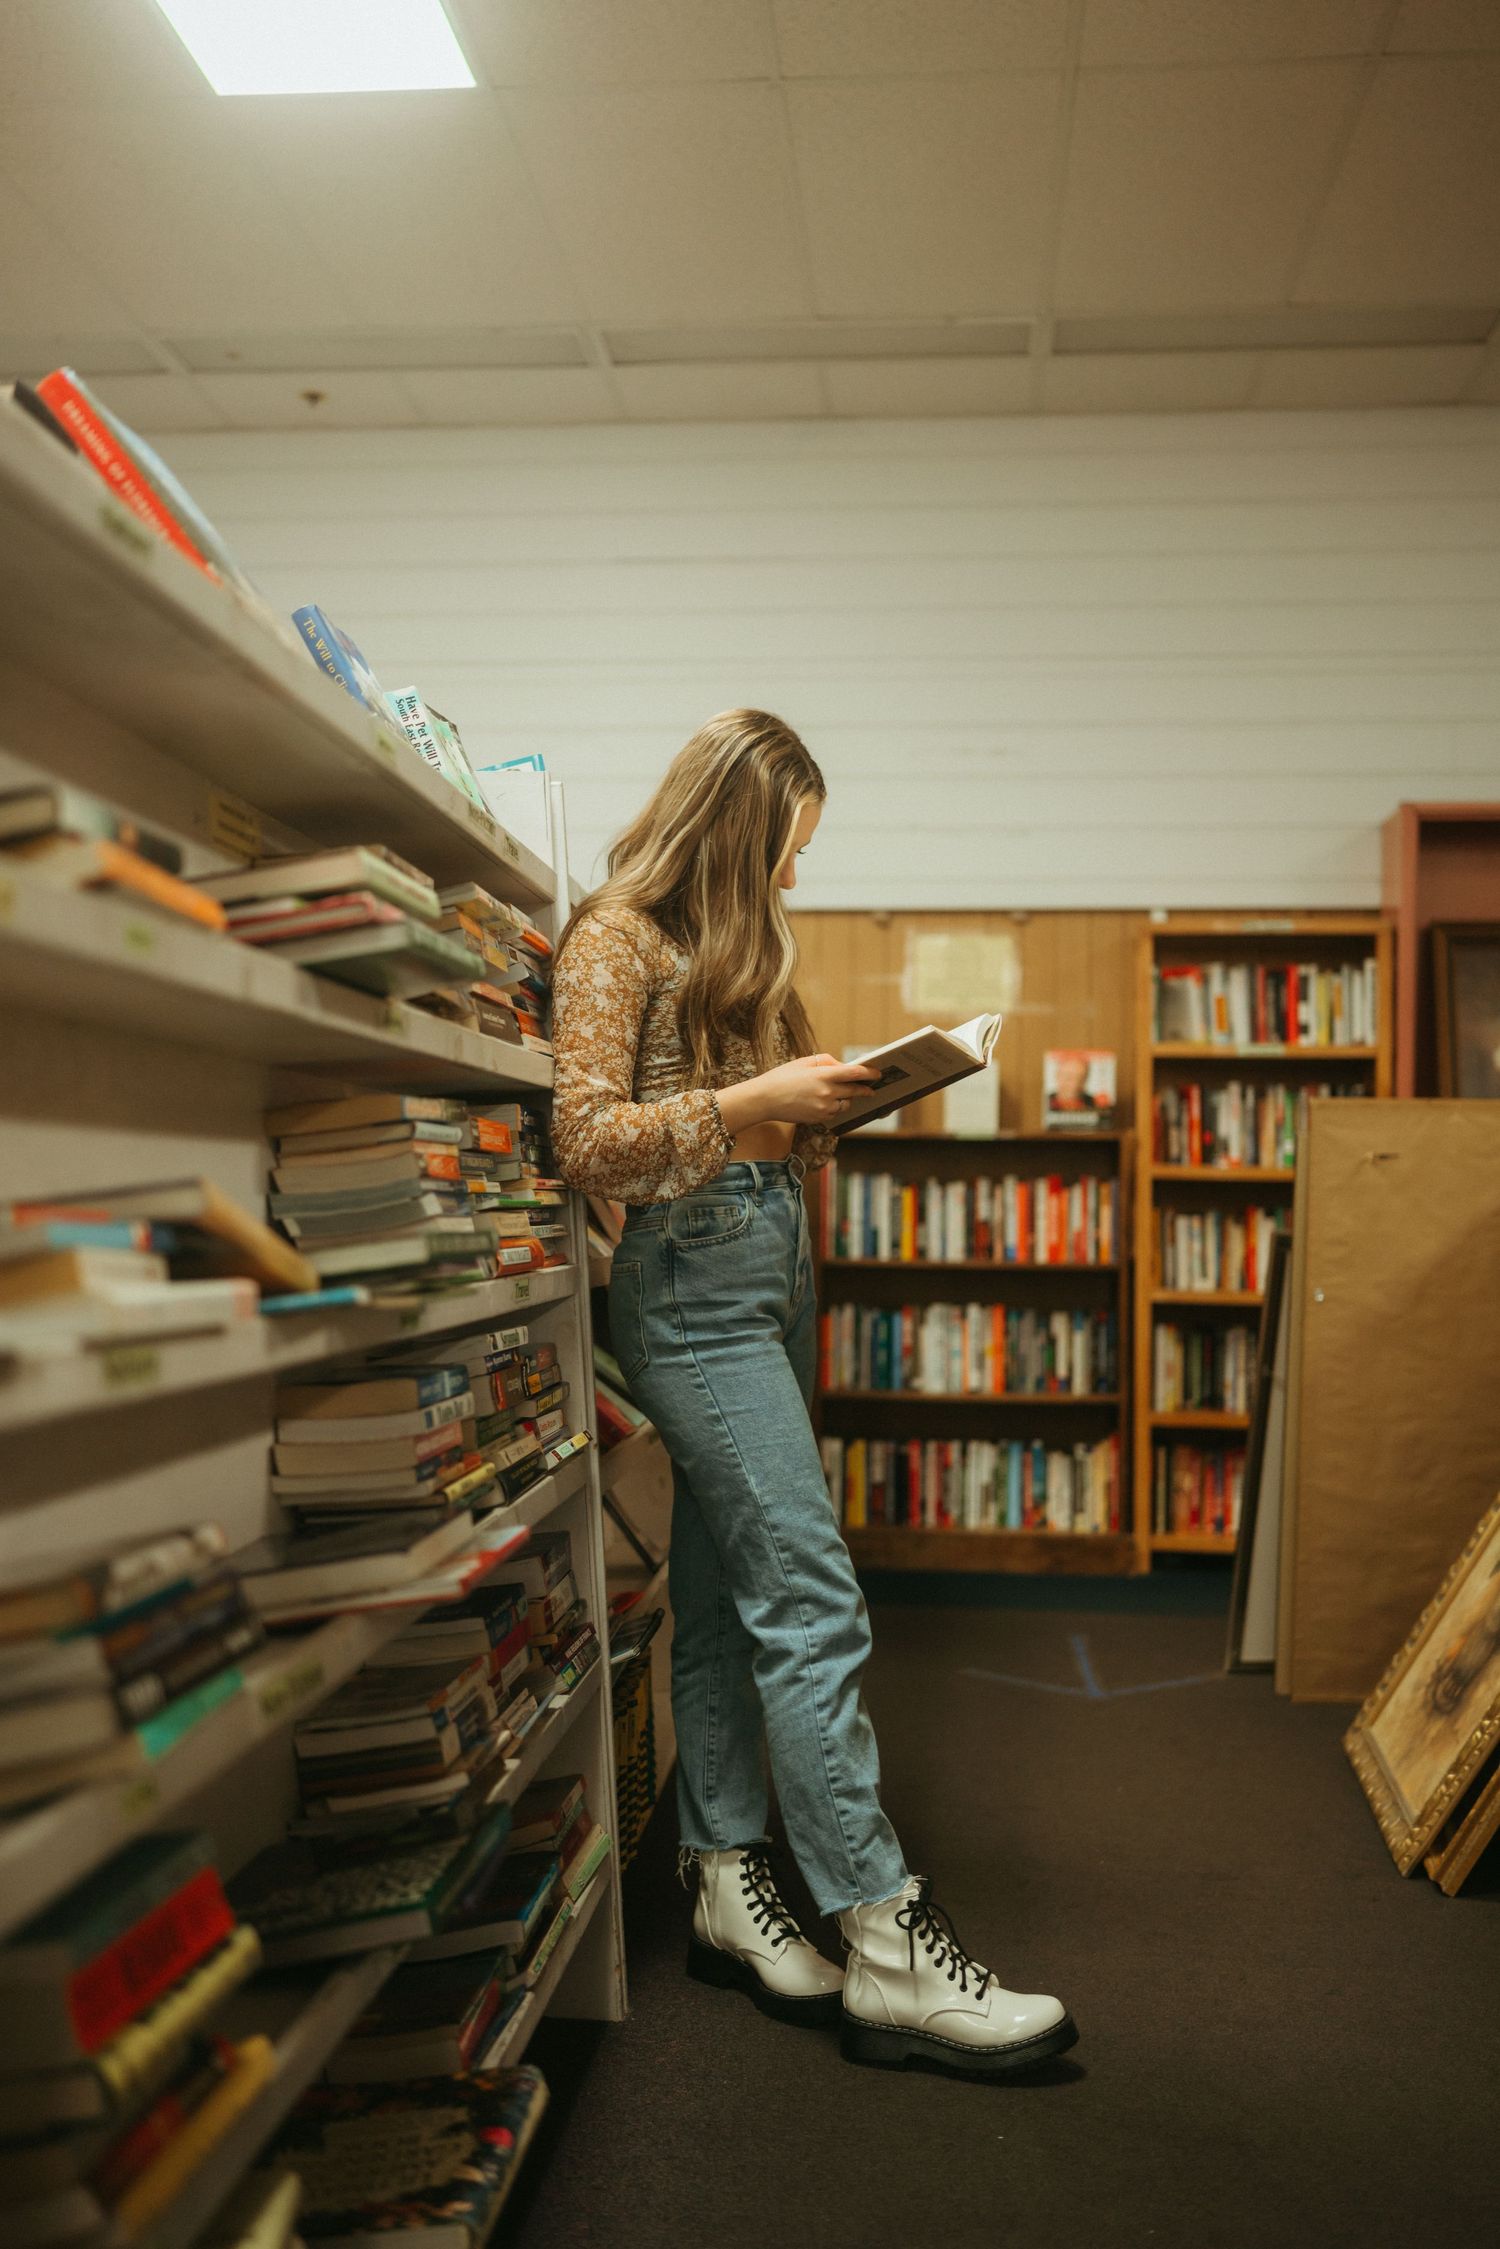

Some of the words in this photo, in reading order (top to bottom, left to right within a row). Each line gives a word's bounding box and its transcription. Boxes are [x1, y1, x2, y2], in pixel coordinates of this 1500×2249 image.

[304, 617, 316, 639] The
[316, 638, 332, 661] Will
[326, 663, 336, 674] to
[395, 698, 410, 723] South
[405, 723, 417, 742] East
[405, 696, 420, 720] Have
[415, 721, 428, 738] Pet
[423, 739, 438, 760] Will
